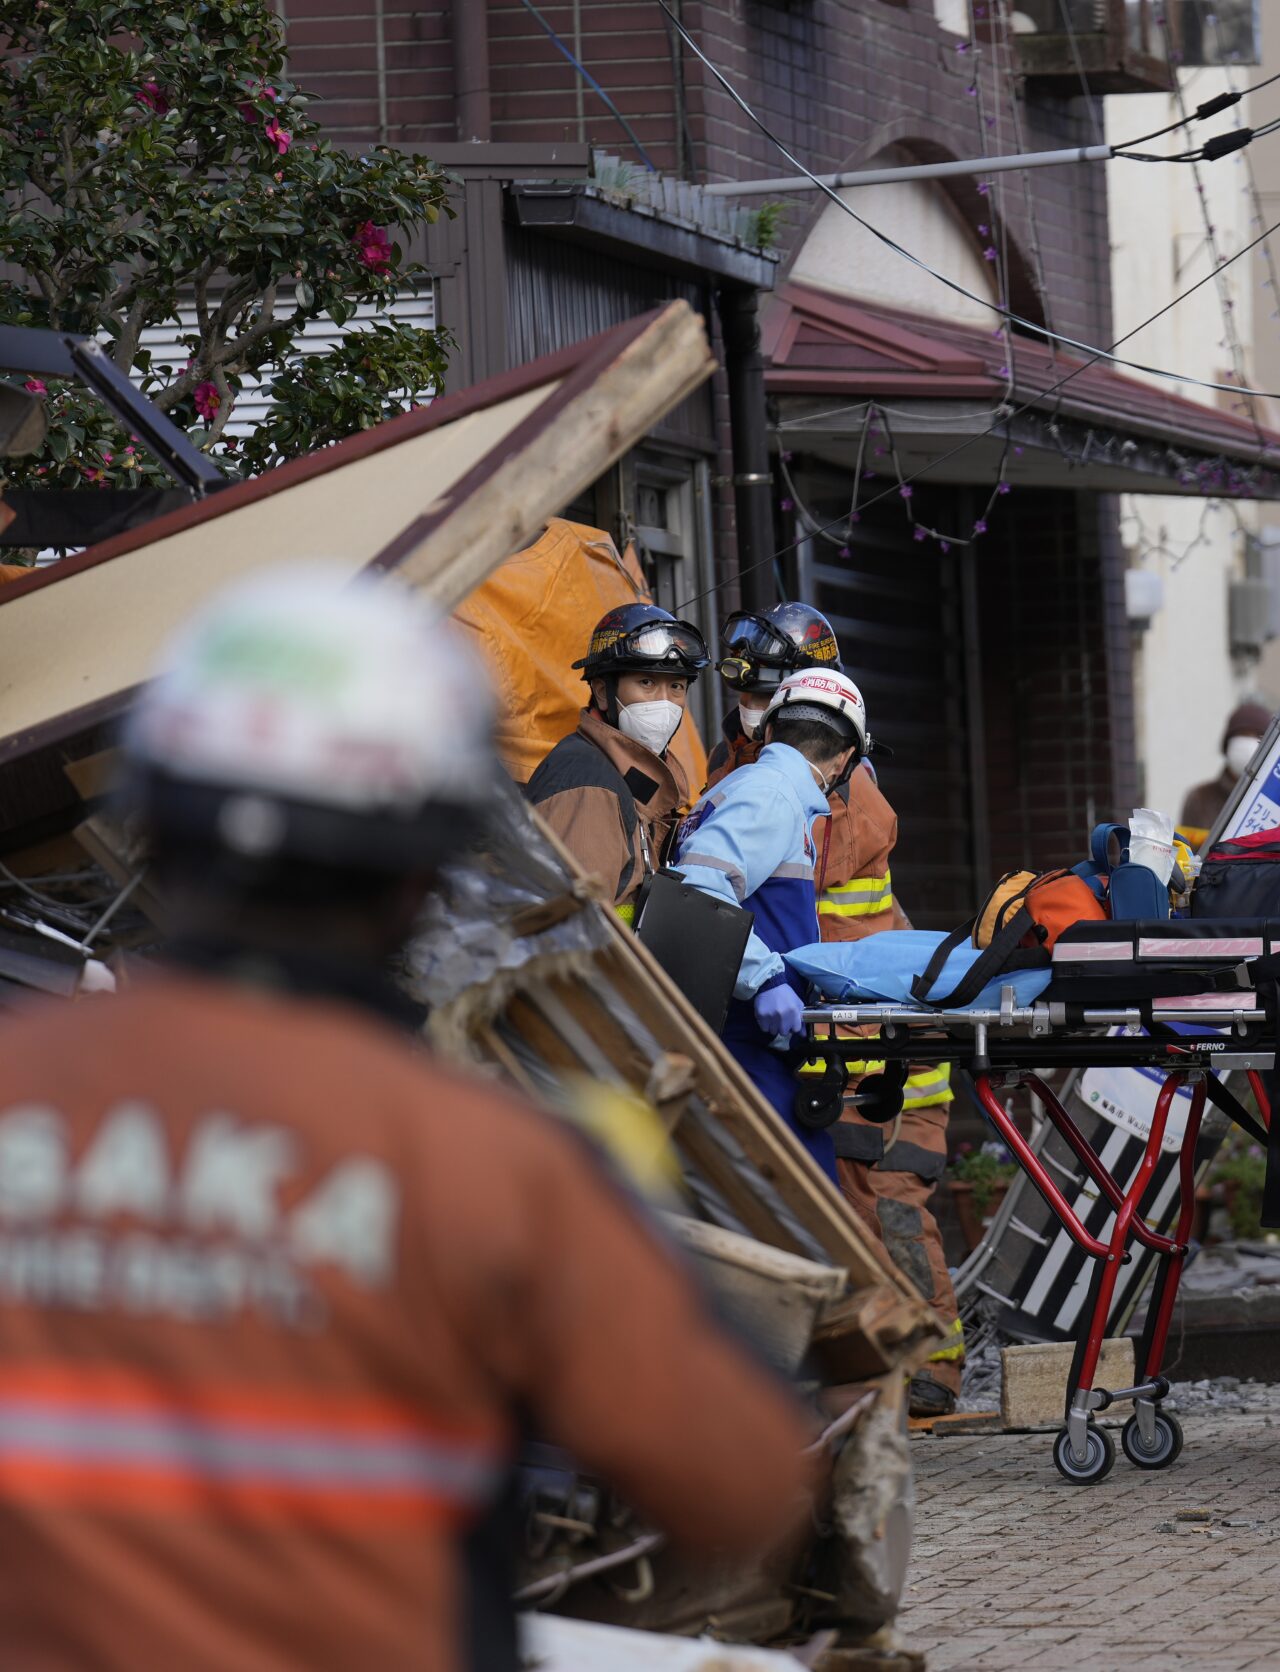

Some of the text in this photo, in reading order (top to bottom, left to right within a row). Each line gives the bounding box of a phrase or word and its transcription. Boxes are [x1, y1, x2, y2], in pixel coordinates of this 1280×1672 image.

[1252, 803, 1278, 825] フリー
[1245, 818, 1265, 833] ダイヤ
[1196, 1042, 1225, 1051] FERNO
